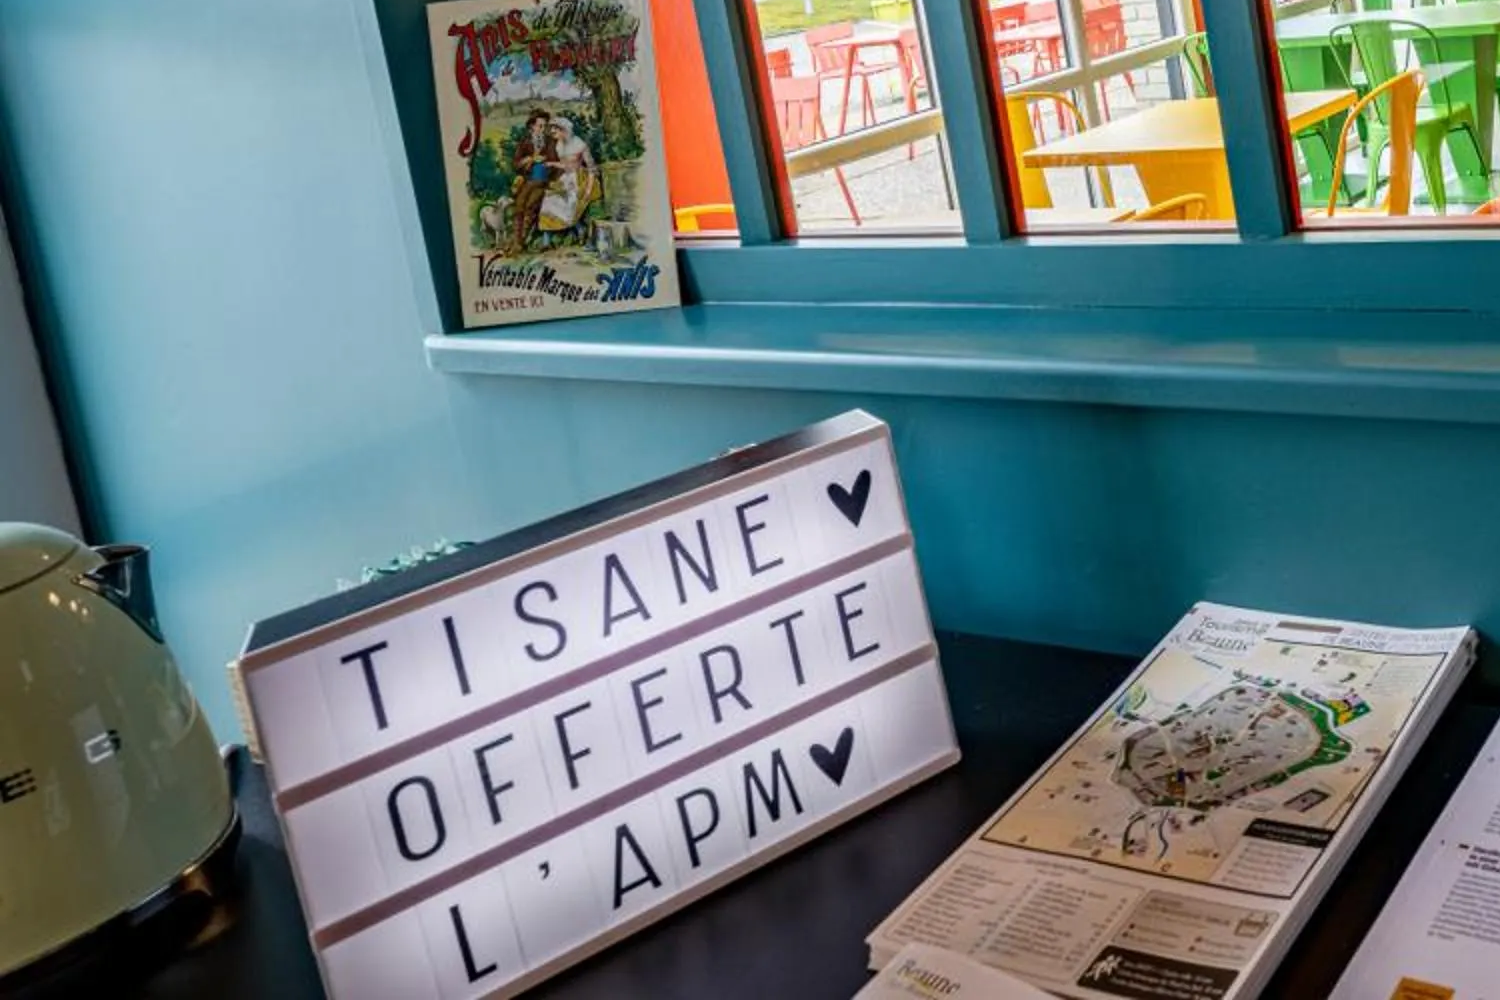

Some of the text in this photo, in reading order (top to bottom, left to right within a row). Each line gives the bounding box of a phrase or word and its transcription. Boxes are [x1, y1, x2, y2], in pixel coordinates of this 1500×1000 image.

[536, 266, 584, 303] Marque
[475, 295, 545, 313] EN VENTE ICI
[340, 495, 784, 731] TISANE
[388, 582, 881, 862] OFFERTE
[897, 960, 961, 995] Beaune
